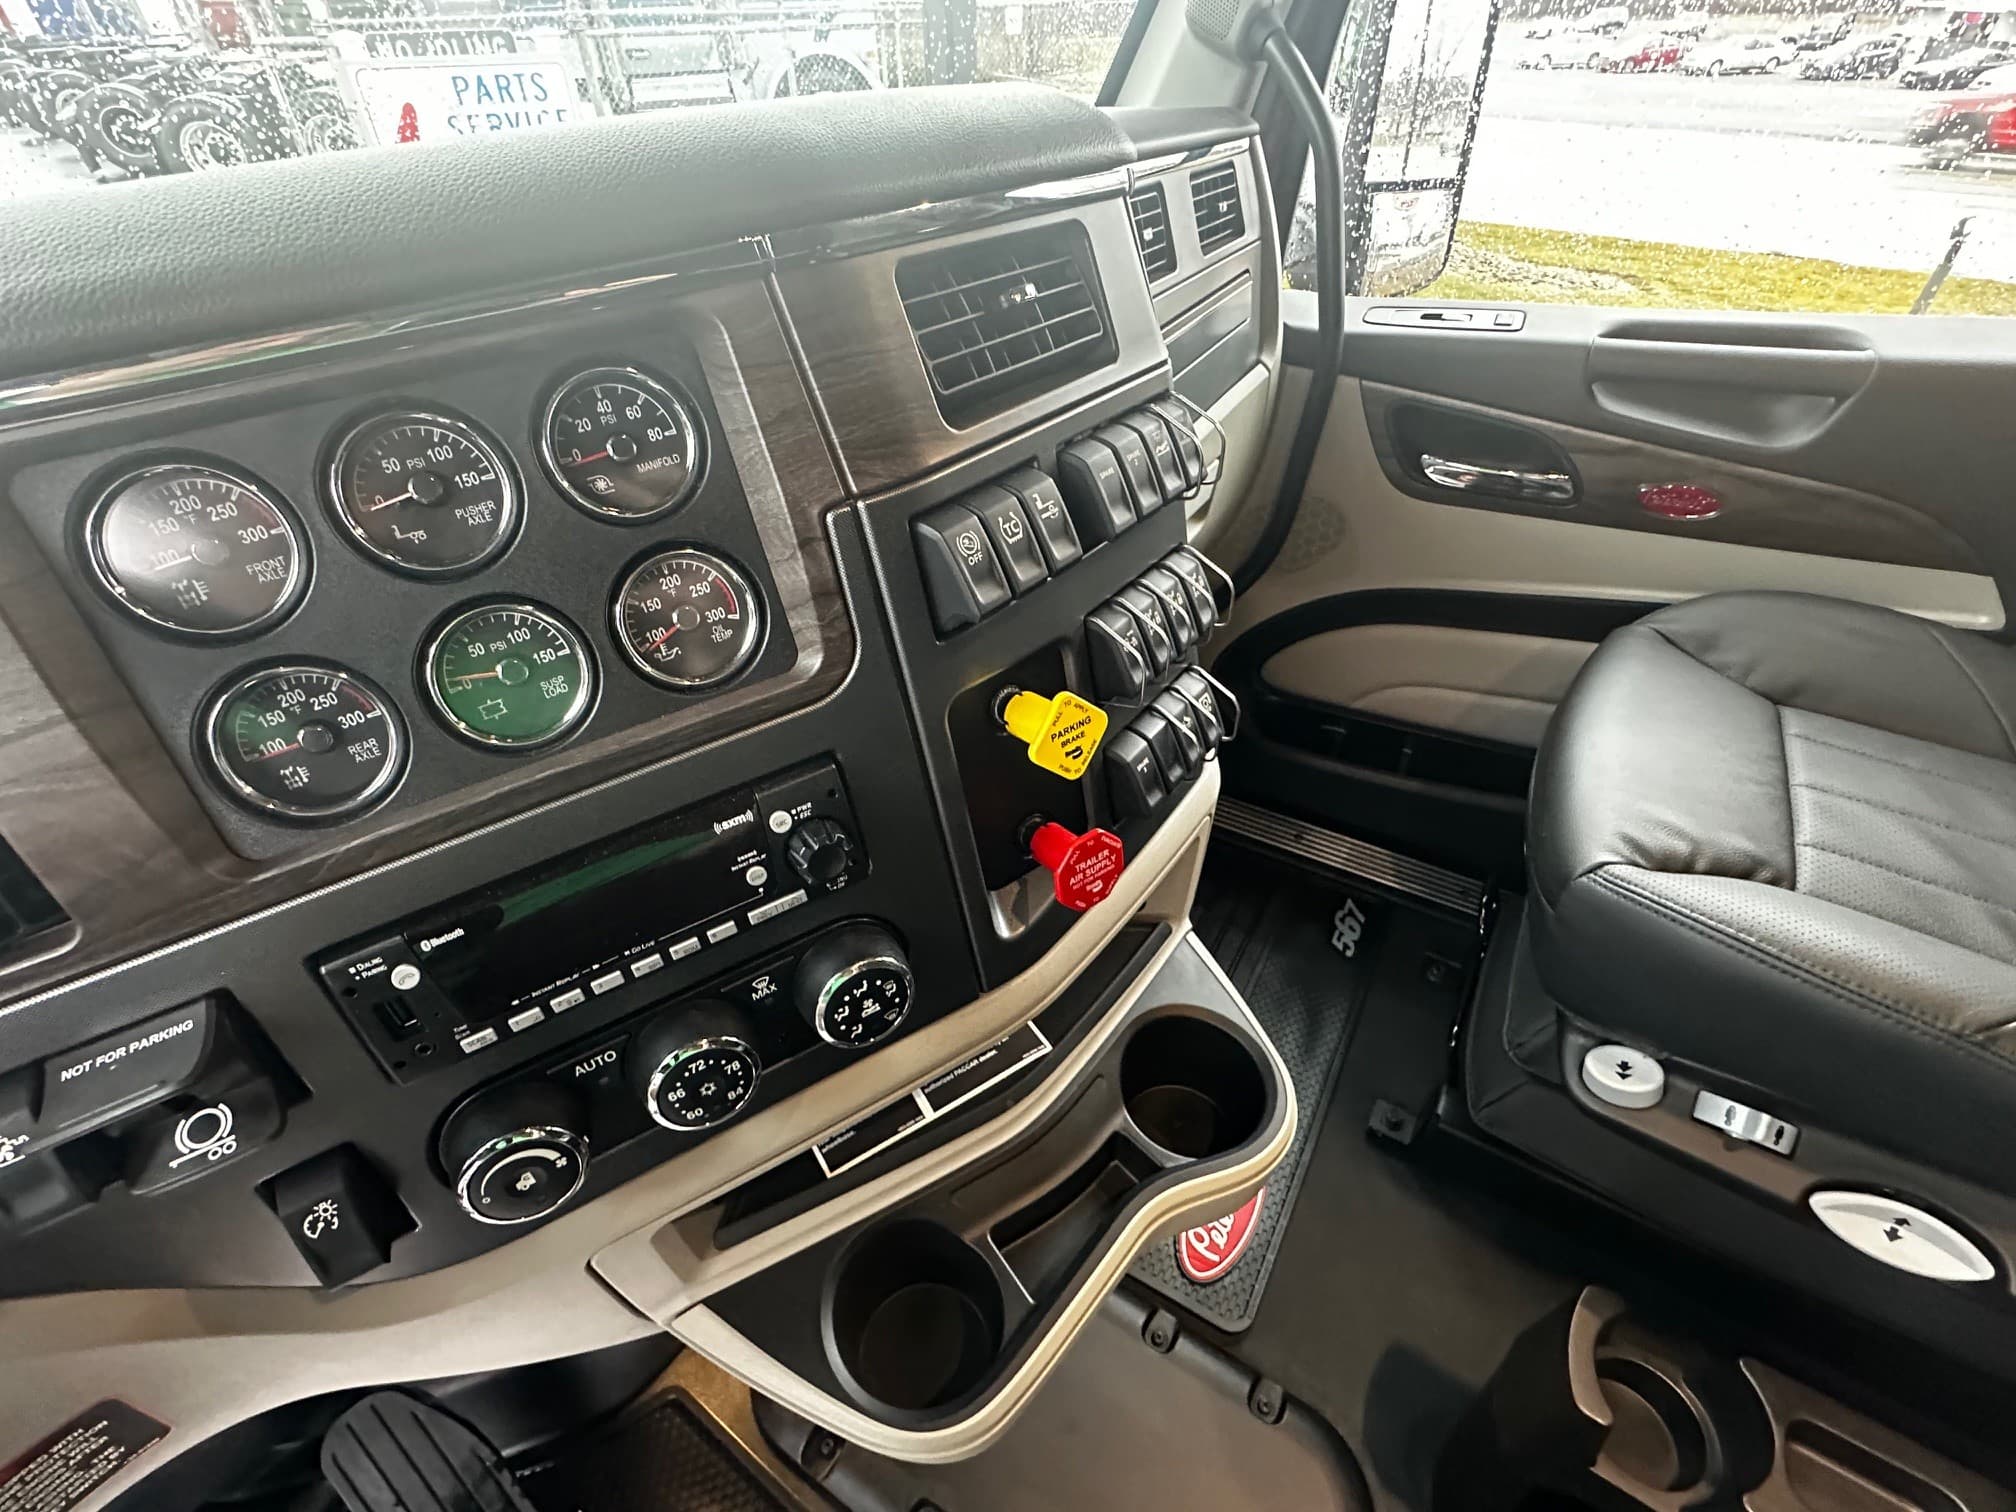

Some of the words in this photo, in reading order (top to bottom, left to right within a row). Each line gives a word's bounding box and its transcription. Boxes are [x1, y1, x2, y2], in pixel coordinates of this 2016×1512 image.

[451, 72, 548, 106] PARTS
[597, 399, 612, 413] 40
[626, 405, 641, 420] 60
[575, 418, 591, 433] 20
[601, 415, 616, 426] PSI
[647, 427, 663, 442] 80
[427, 445, 453, 463] 100
[572, 449, 581, 462] 0
[382, 457, 400, 473] 50
[407, 459, 425, 470] PSI
[637, 454, 680, 473] MANIFOLD
[455, 471, 479, 489] 150
[170, 495, 202, 516] 200
[207, 502, 238, 522] 250
[455, 500, 496, 519] PUSHER
[149, 517, 179, 536] 150
[468, 512, 493, 527] AXLE
[238, 525, 268, 544] 300
[1003, 520, 1020, 536] TC
[246, 556, 286, 575] FRONT
[968, 552, 983, 565] OFF
[258, 568, 287, 584] AXLE
[660, 574, 681, 590] 200
[690, 582, 710, 598] 250
[641, 598, 662, 613] 150
[705, 607, 725, 623] 300
[507, 628, 531, 644] 100
[711, 630, 733, 644] TEMP
[468, 642, 485, 658] 50
[490, 642, 507, 653] PSI
[533, 648, 556, 665] 150
[540, 676, 564, 691] SUSP
[544, 683, 568, 699] LOAD
[278, 688, 305, 708] 200
[310, 692, 338, 711] 250
[258, 710, 285, 728] 150
[338, 710, 365, 729] 300
[1051, 716, 1091, 743] PARKING
[259, 738, 287, 756] 100
[348, 738, 378, 754] REAR
[1061, 731, 1085, 748] BRAKE
[355, 748, 382, 764] AXLE
[1075, 849, 1109, 872] TRAILER
[1070, 873, 1083, 886] AIR
[1085, 854, 1116, 877] SUPPLY
[1331, 898, 1366, 957] 567
[752, 983, 778, 1000] MAX
[61, 1060, 93, 1082] NOT
[95, 1046, 127, 1067] FOR
[129, 1020, 194, 1053] PARKING
[575, 1050, 617, 1077] AUTO
[688, 1059, 706, 1075] 72
[724, 1060, 741, 1075] 78
[667, 1088, 686, 1102] 66
[727, 1087, 744, 1100] 84
[686, 1107, 704, 1120] 60
